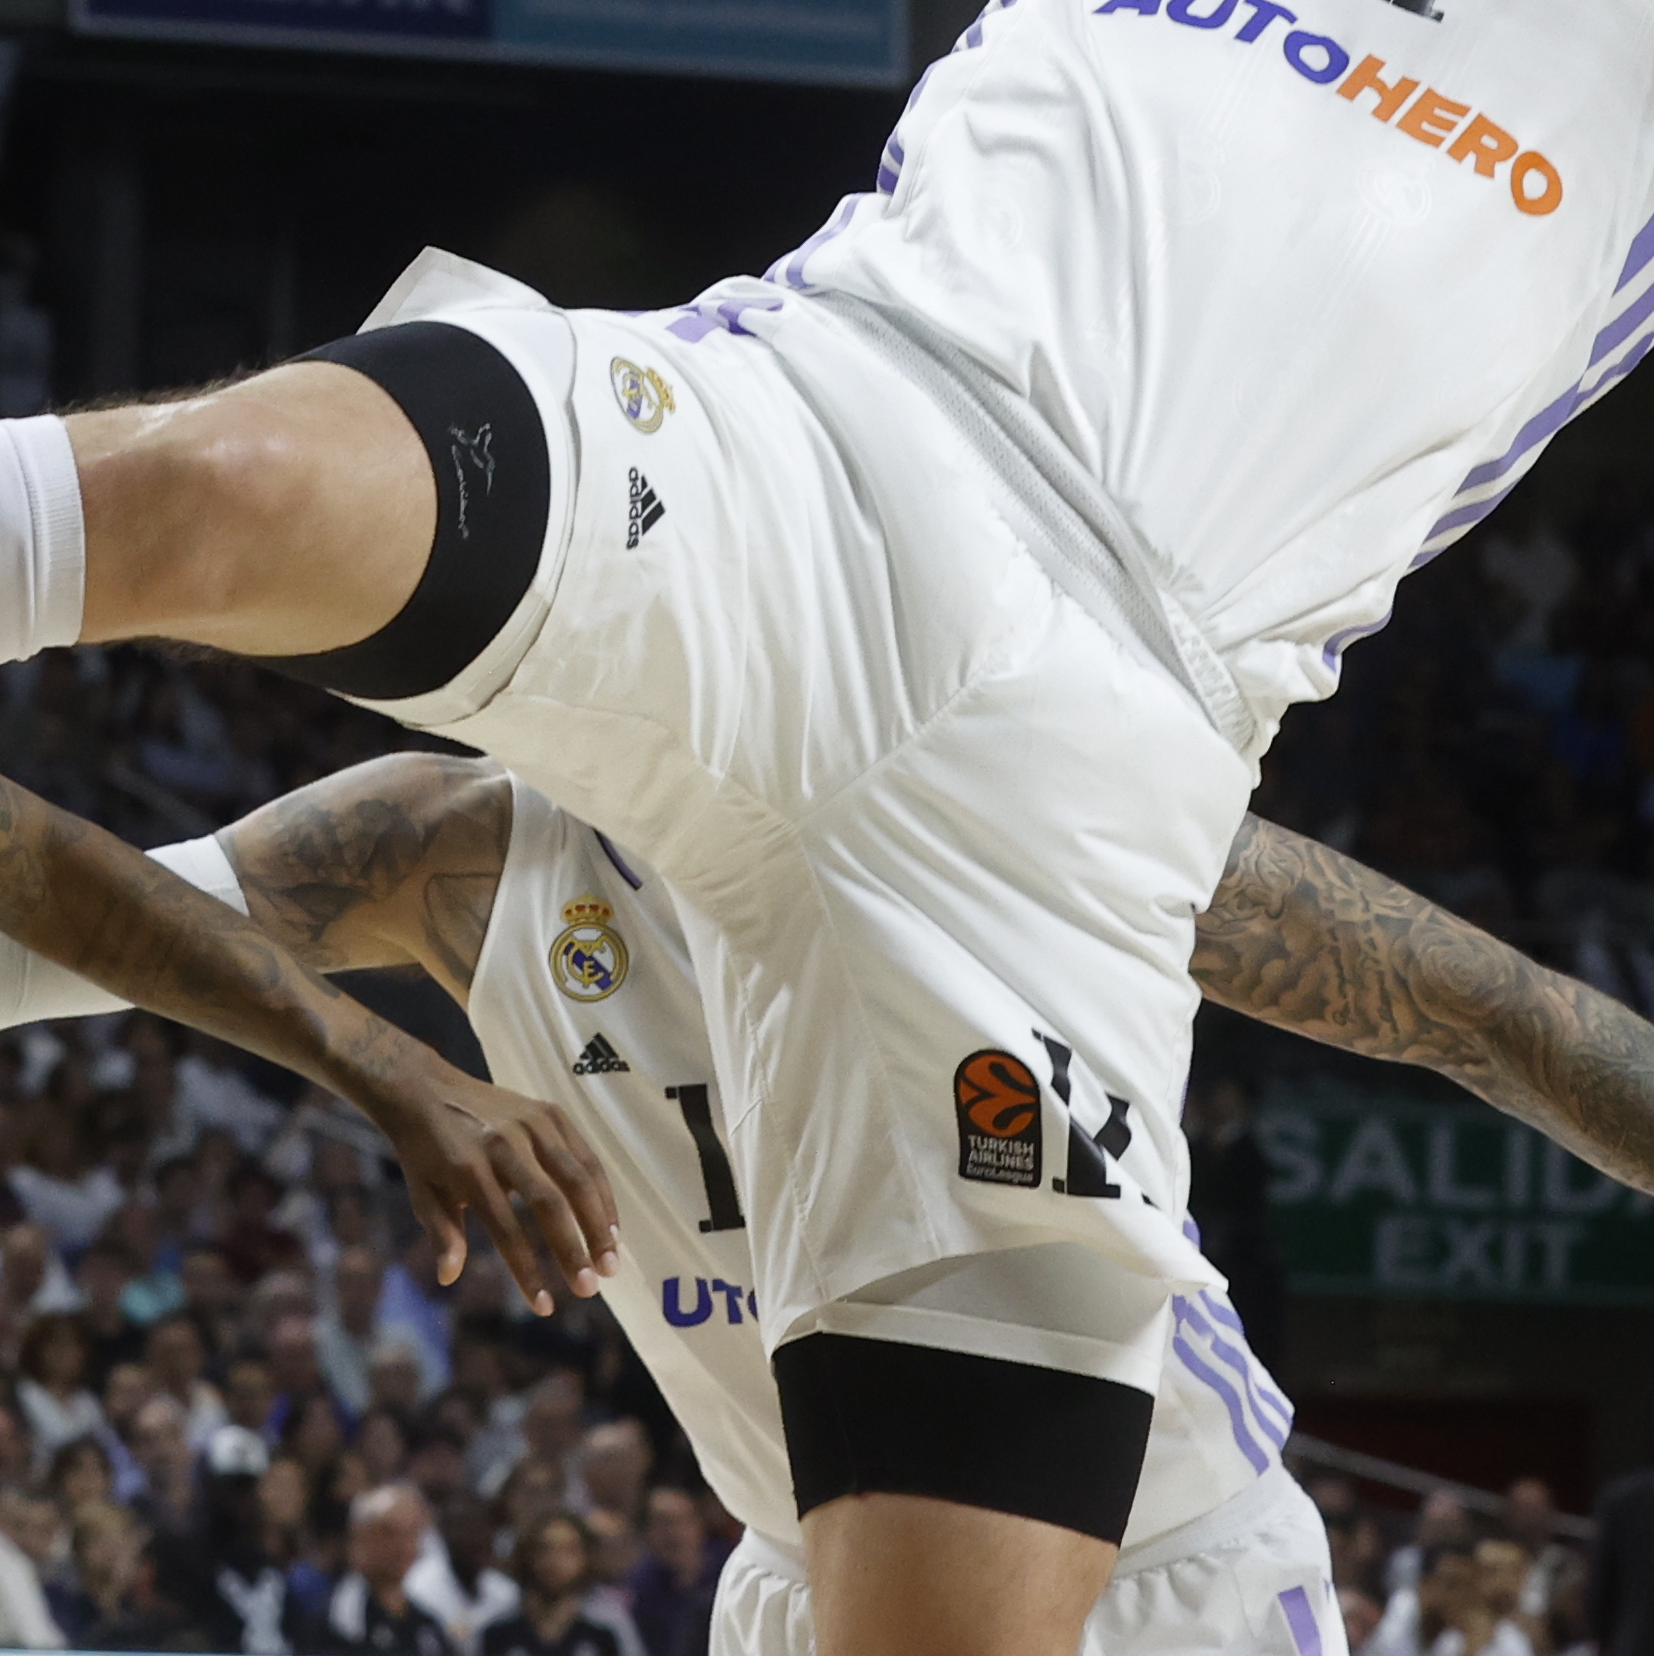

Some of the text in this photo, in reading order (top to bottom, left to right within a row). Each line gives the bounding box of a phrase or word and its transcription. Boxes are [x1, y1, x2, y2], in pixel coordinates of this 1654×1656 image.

[626, 466, 643, 551] adidas
[572, 1056, 632, 1076] adidas
[664, 1083, 746, 1233] 1
[967, 1134, 1035, 1155] TURKISH
[968, 1148, 1035, 1172] AIRLINES
[1375, 1213, 1587, 1291] EXIT
[662, 1275, 759, 1328] UT
